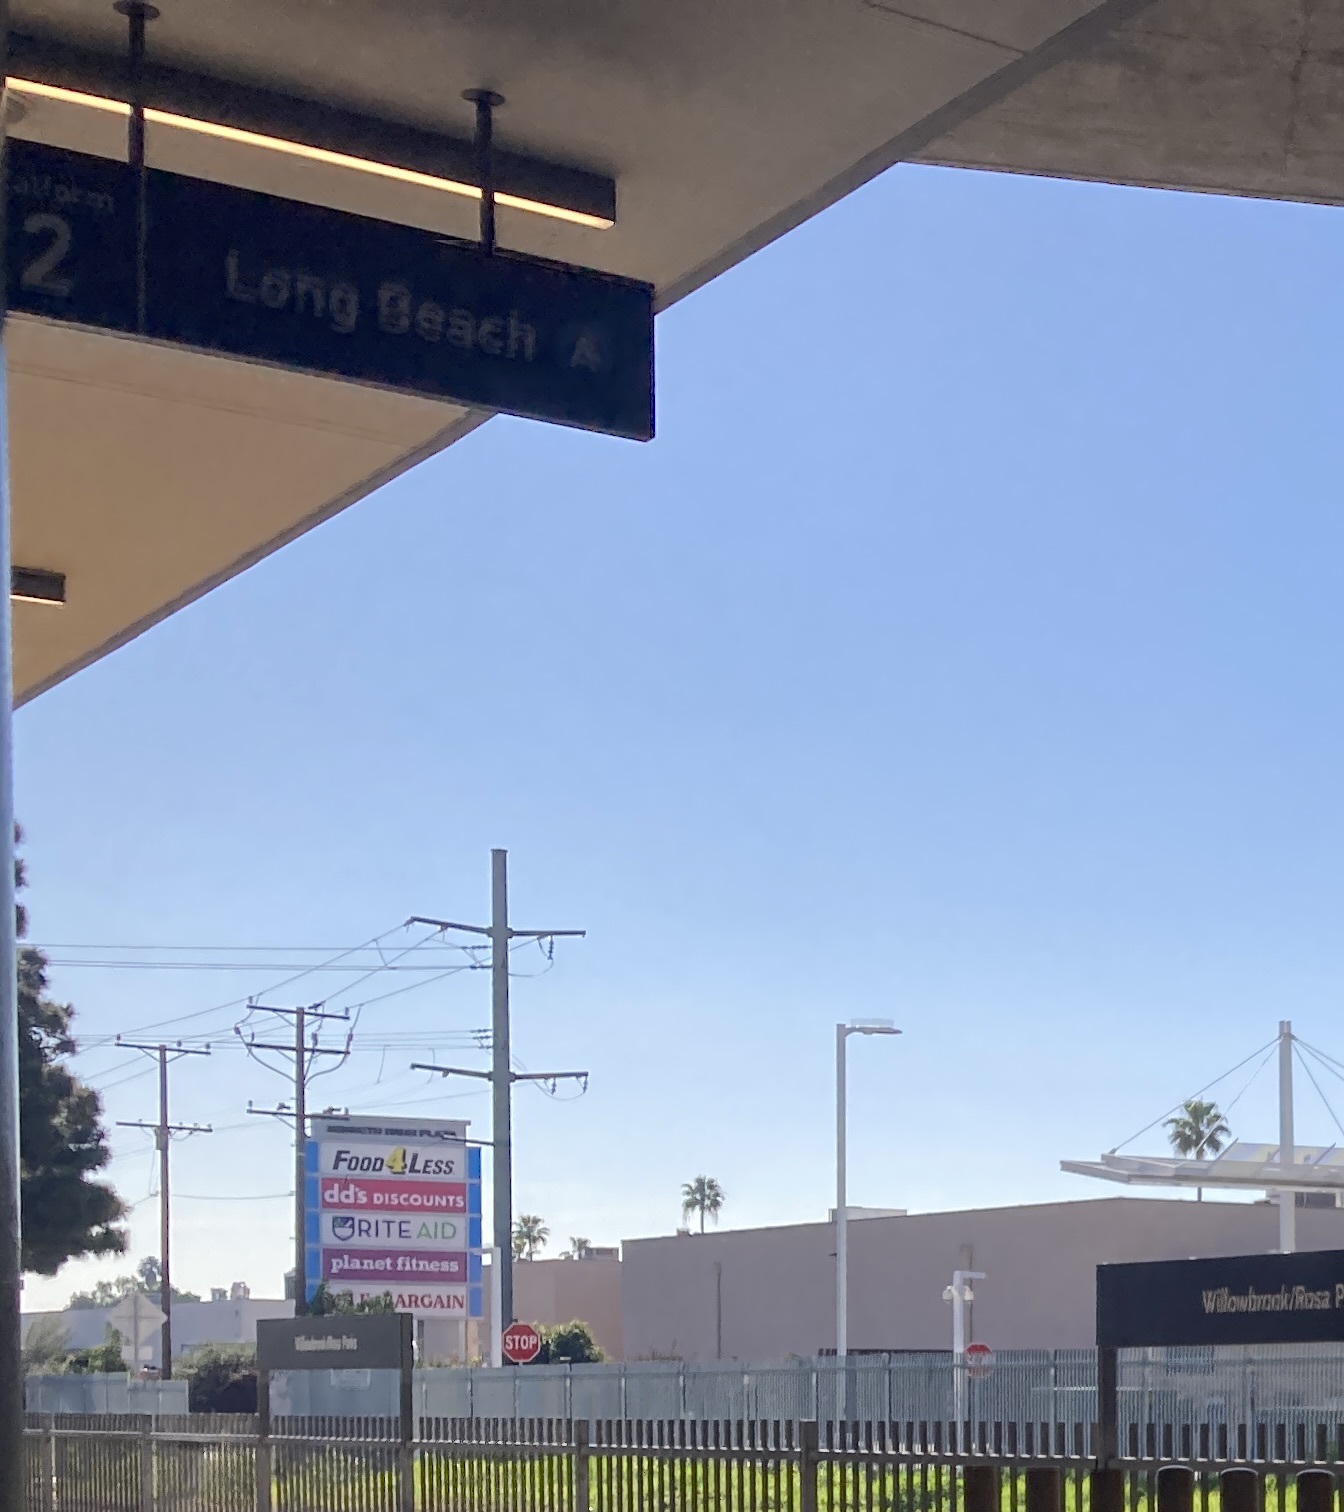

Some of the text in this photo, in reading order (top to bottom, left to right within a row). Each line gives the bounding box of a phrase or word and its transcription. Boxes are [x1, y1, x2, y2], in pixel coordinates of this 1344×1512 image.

[22, 212, 74, 298] 2
[225, 249, 538, 363] Long Beach
[324, 1183, 464, 1208] dd's DISCOUNTS
[358, 1219, 457, 1239] RITE AID
[330, 1254, 459, 1274] planet fitness
[386, 1293, 464, 1309] ARGAIN
[1202, 1284, 1332, 1314] Willowbrook/Rosa
[505, 1335, 537, 1350] STOP
